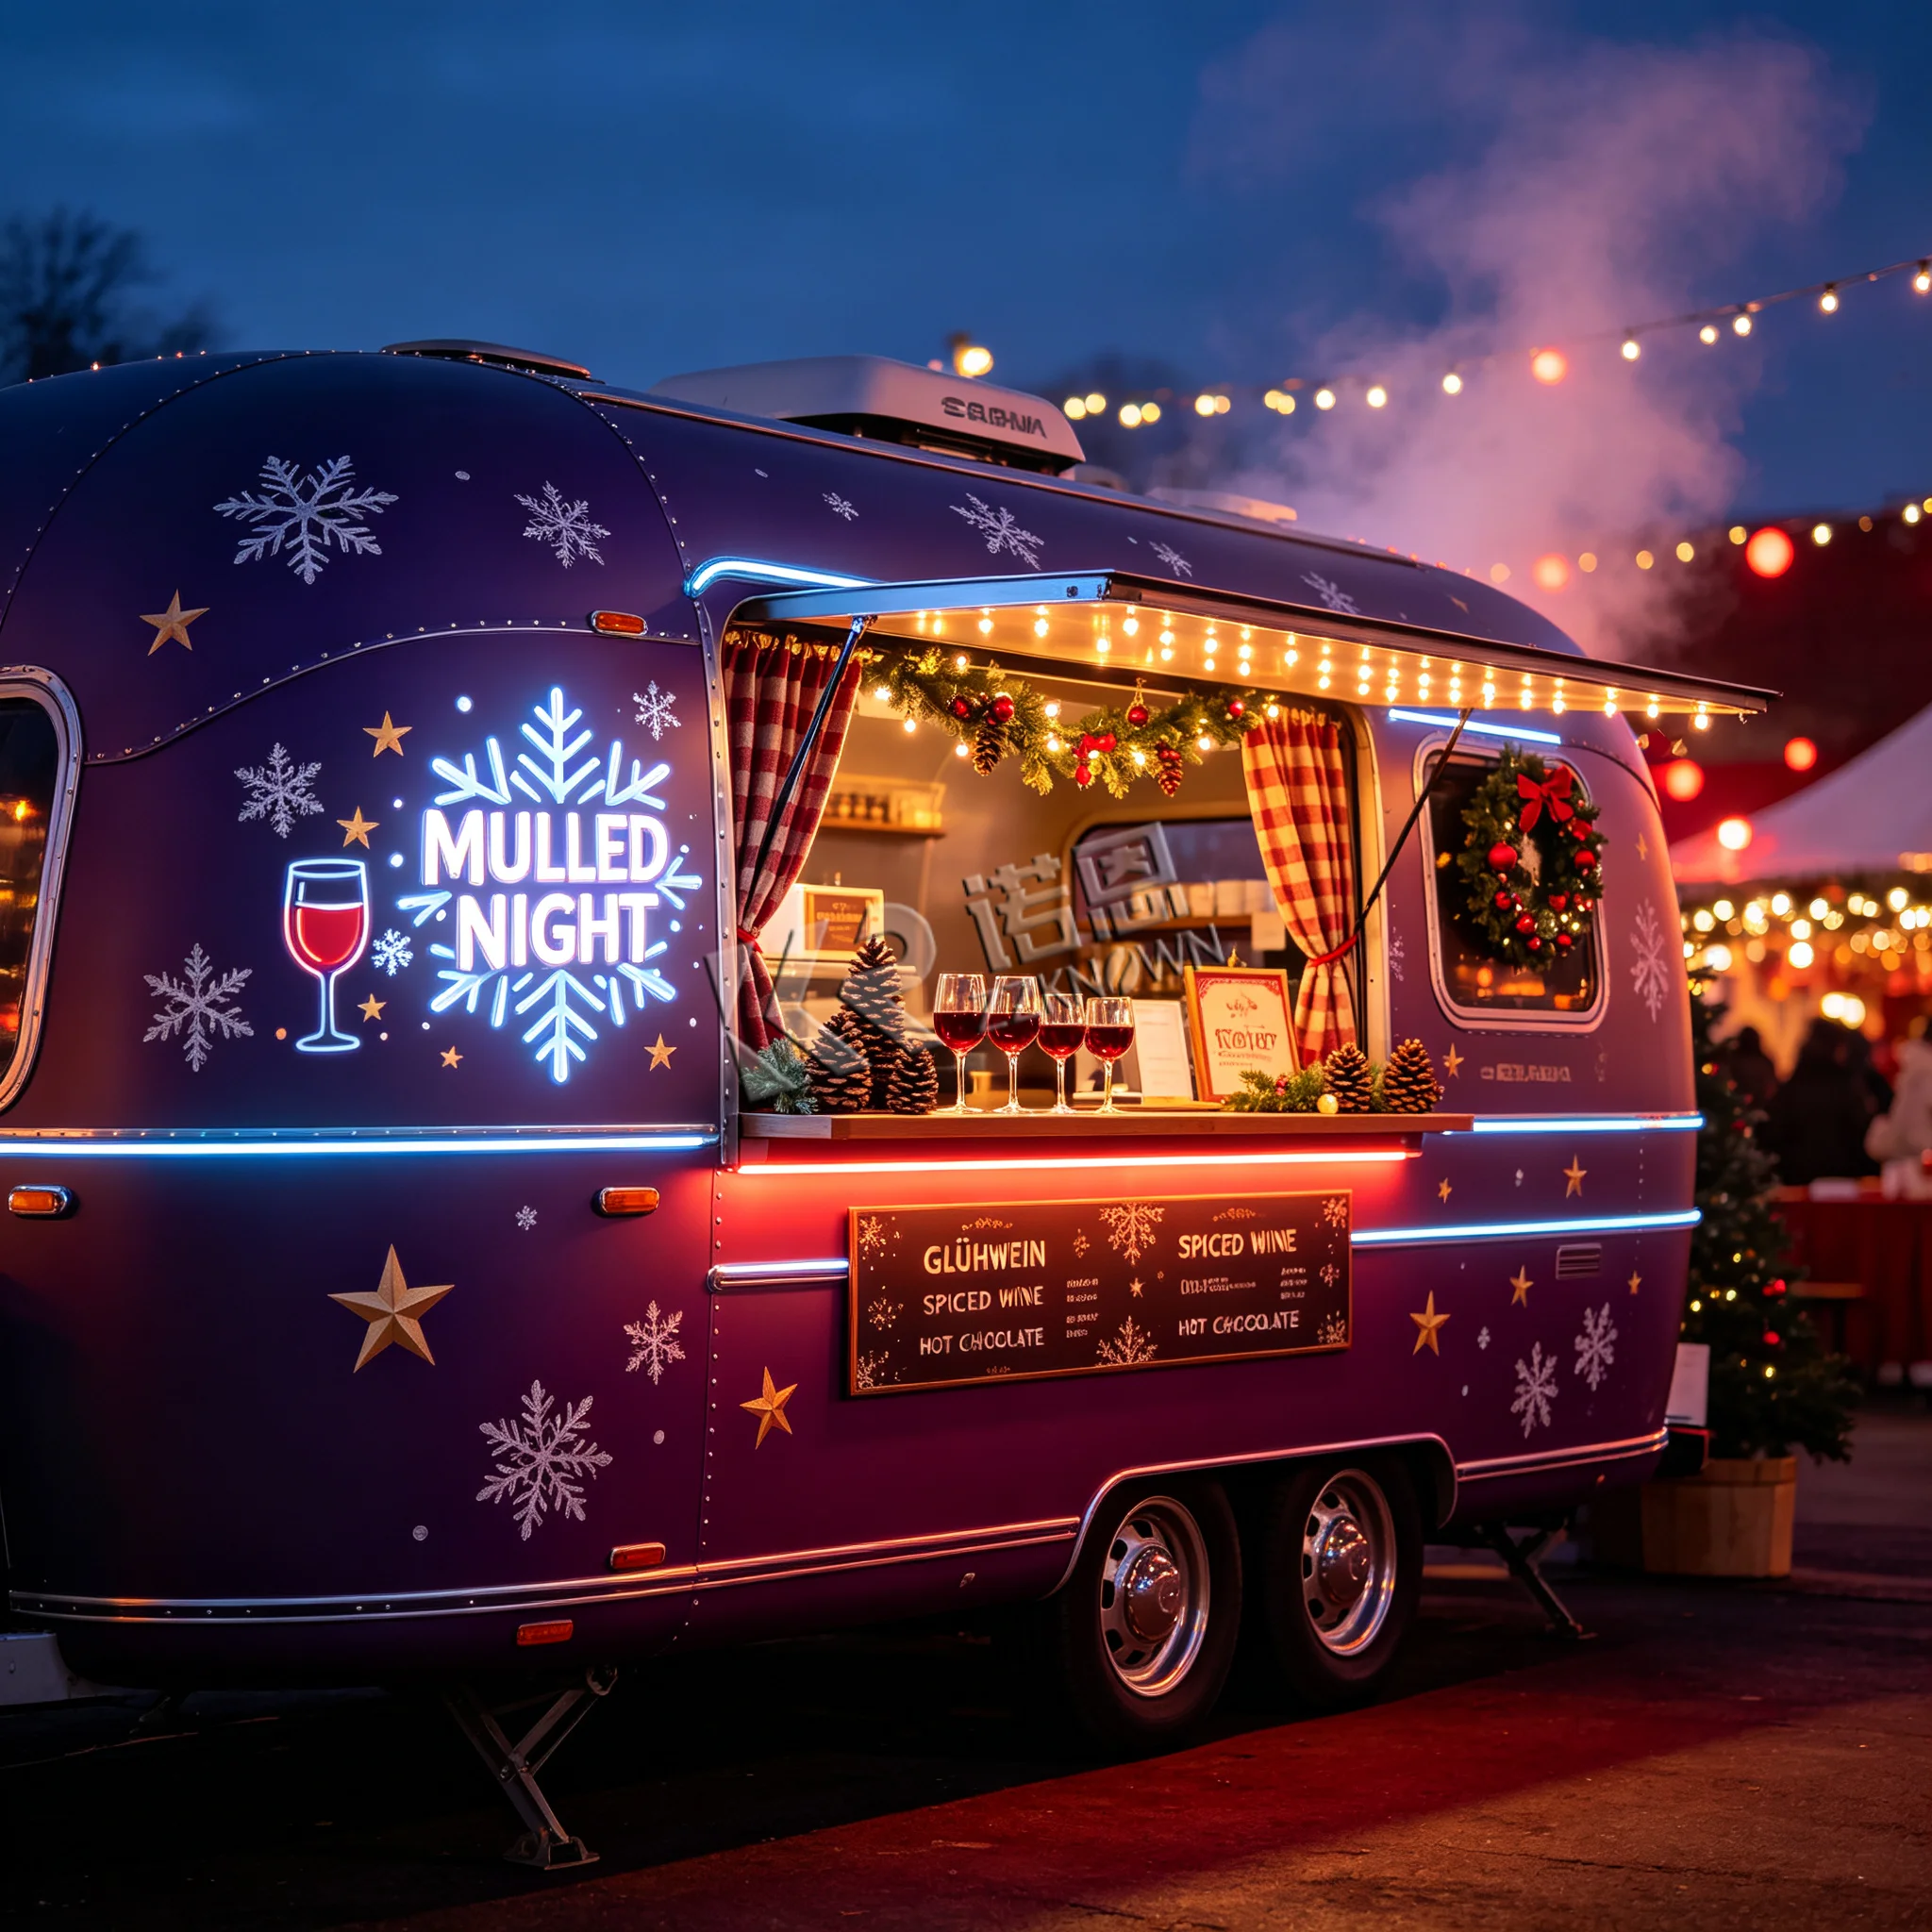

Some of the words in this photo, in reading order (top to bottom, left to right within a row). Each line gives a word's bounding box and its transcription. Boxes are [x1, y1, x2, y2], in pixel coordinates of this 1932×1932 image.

[421, 808, 669, 886] MULLED
[456, 892, 659, 972] NIGHT
[924, 1237, 1045, 1274] GLÜHWEIN
[1177, 1233, 1244, 1259] SPICED
[1250, 1228, 1297, 1255] WINE
[924, 1291, 991, 1315] SPICED
[999, 1286, 1044, 1308] WINE
[1179, 1318, 1208, 1336] HOT
[920, 1335, 954, 1356] HOT
